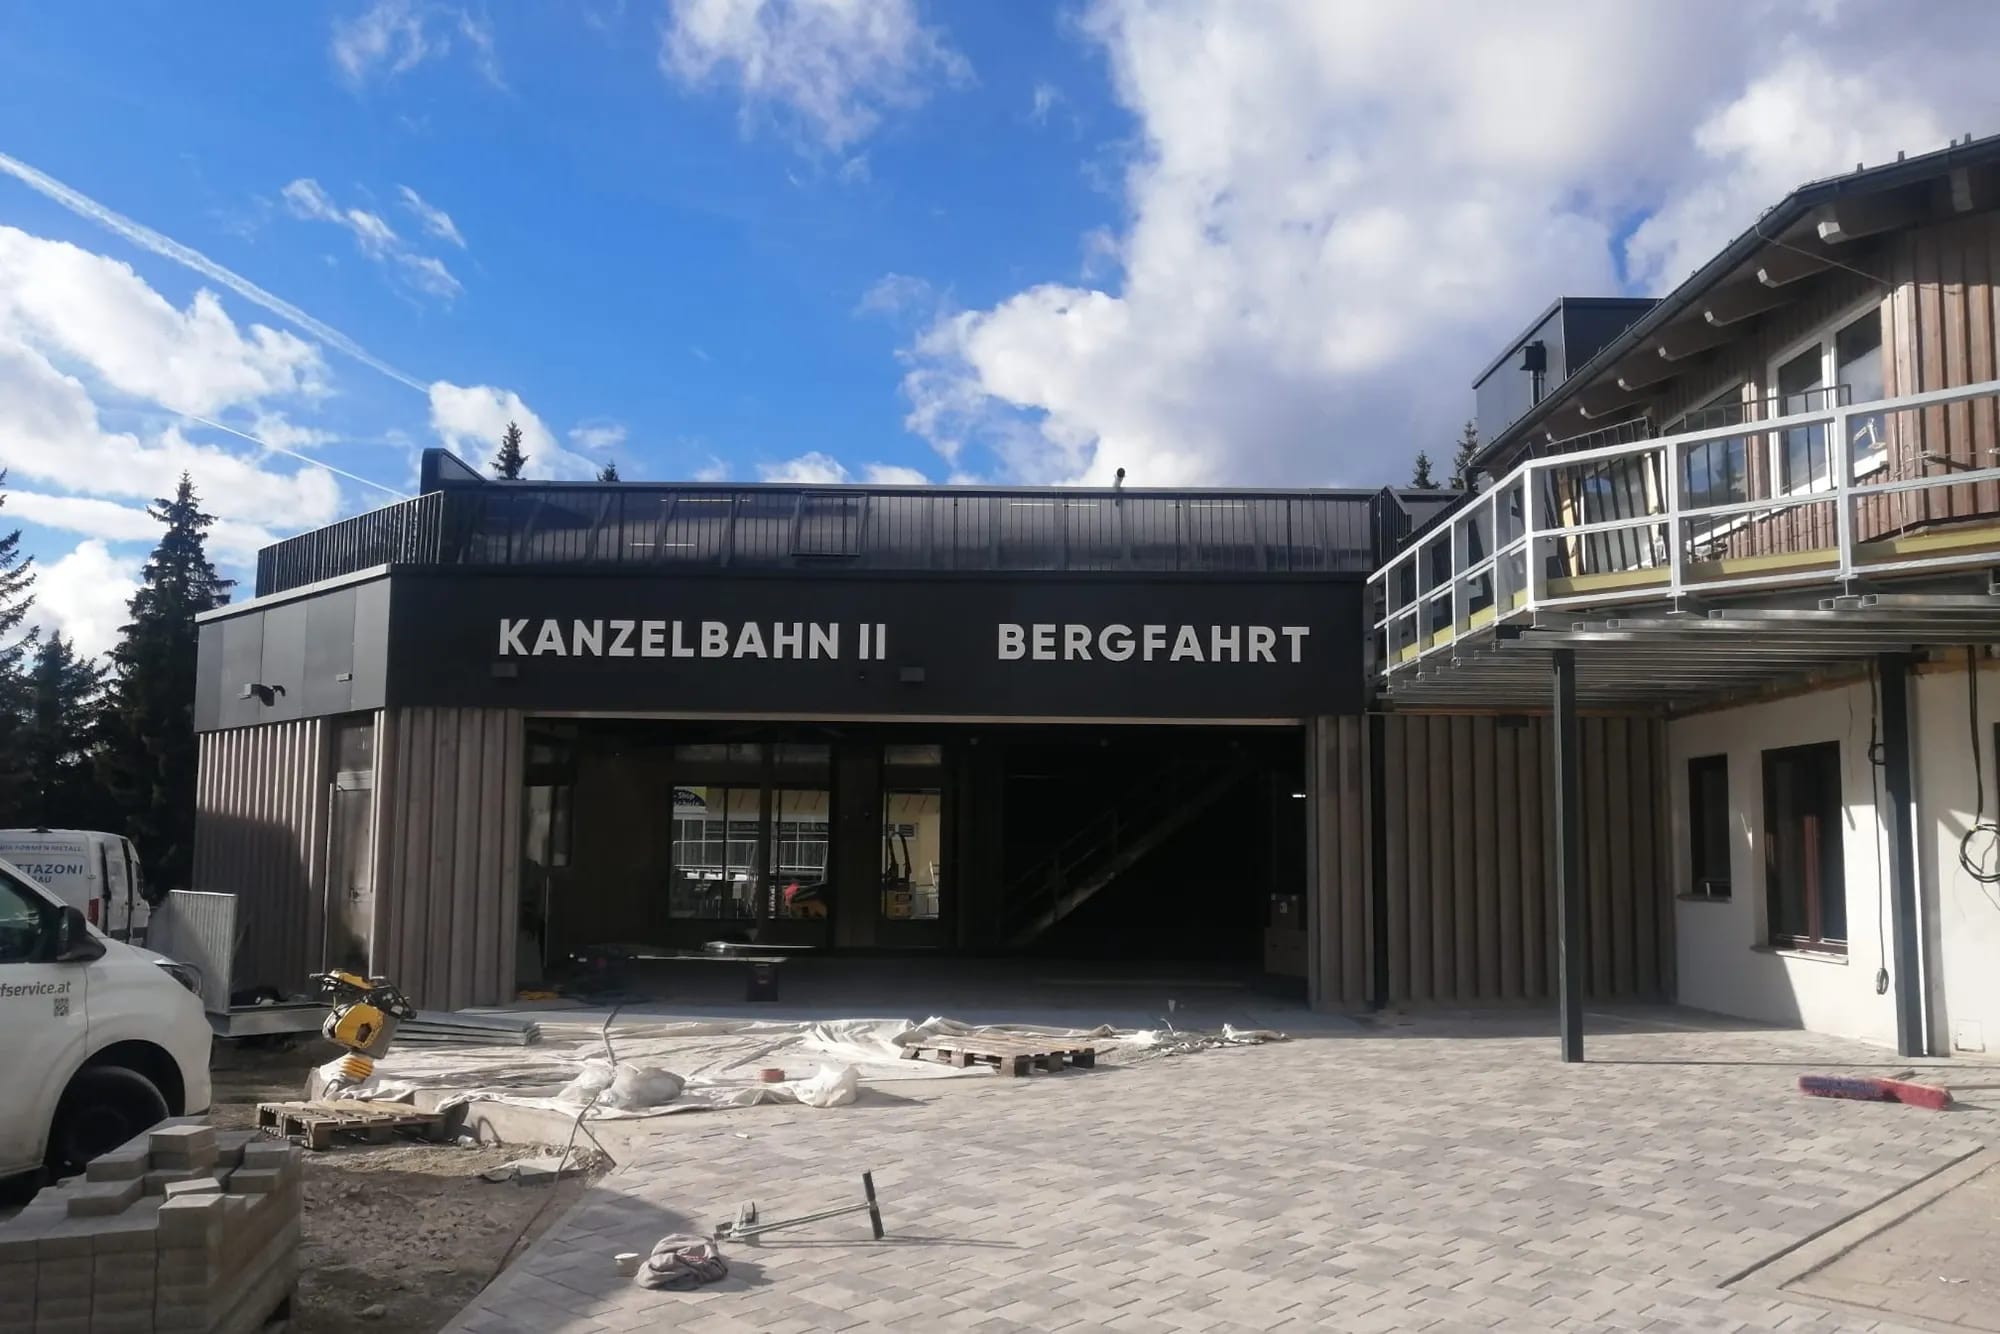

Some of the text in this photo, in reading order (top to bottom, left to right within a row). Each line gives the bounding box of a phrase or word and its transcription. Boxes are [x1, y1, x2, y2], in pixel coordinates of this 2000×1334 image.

[498, 618, 887, 661] KANZELBAHN II
[998, 623, 1311, 664] BERGFAHRT
[0, 981, 71, 997] fservice.at
